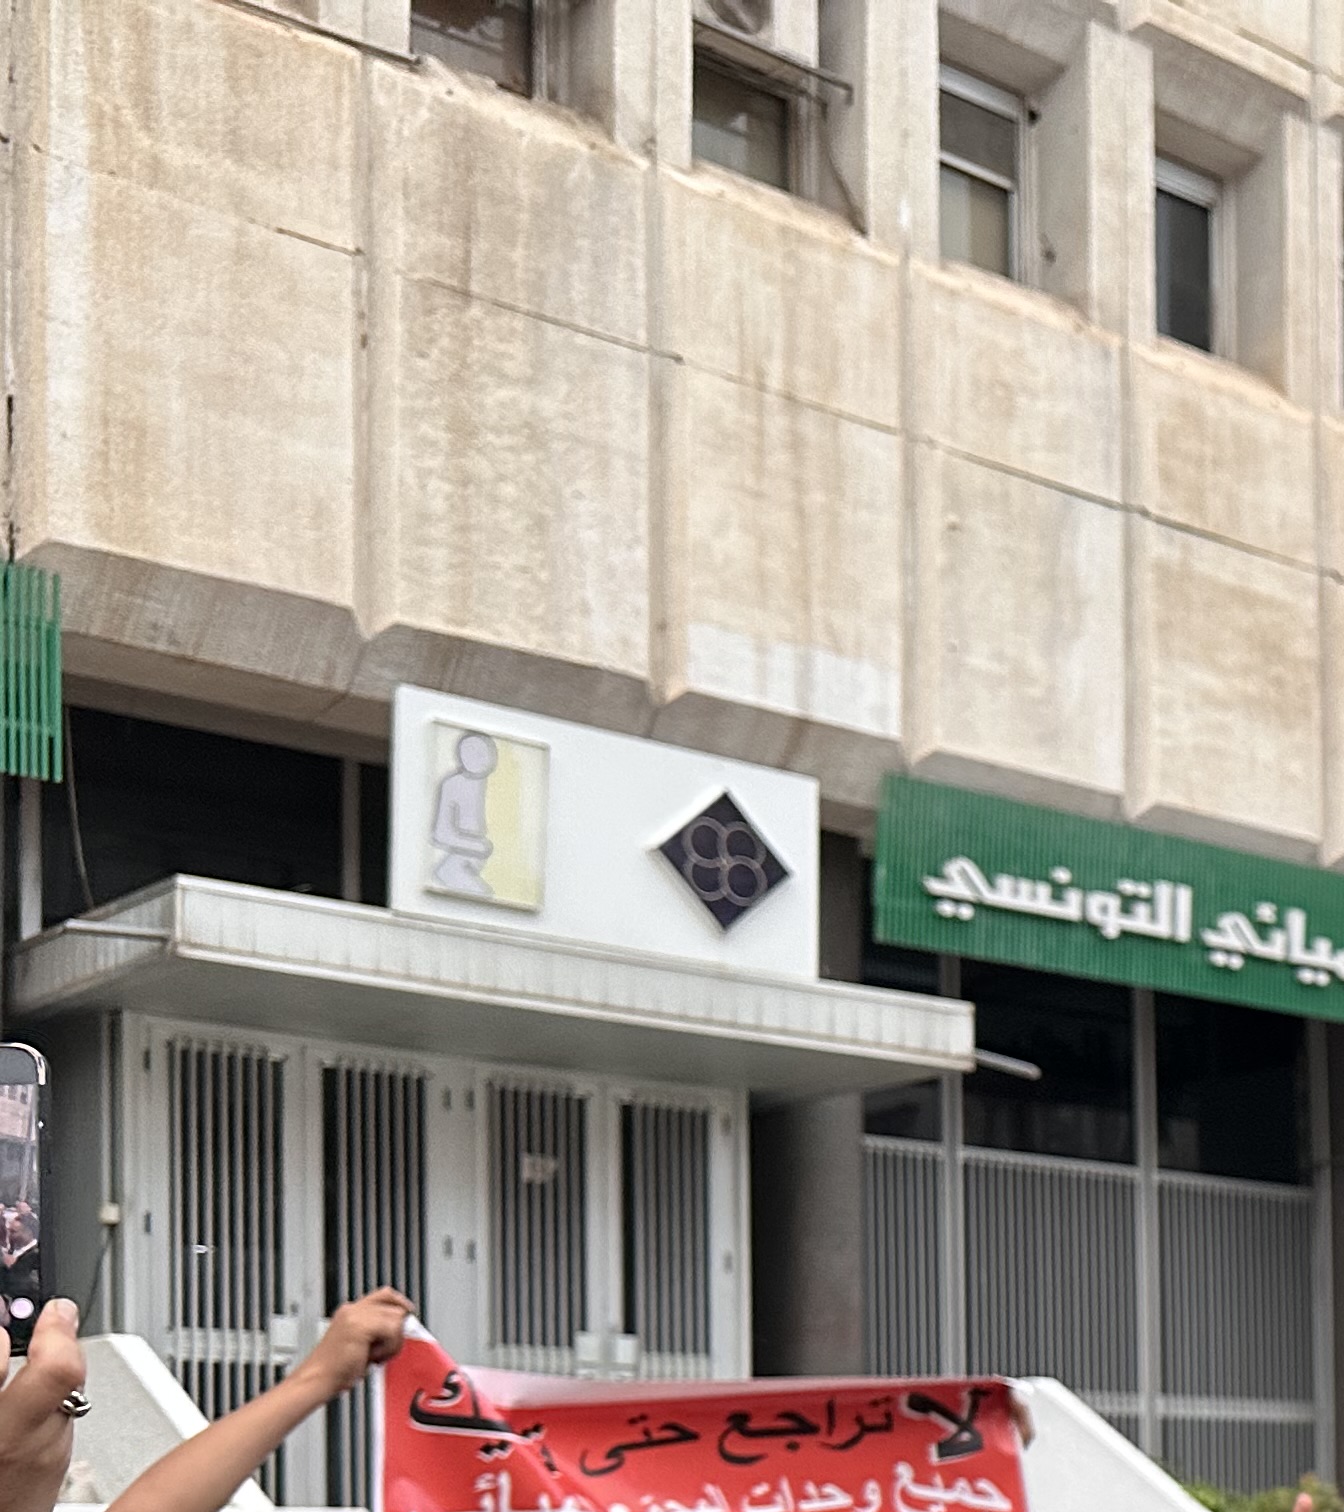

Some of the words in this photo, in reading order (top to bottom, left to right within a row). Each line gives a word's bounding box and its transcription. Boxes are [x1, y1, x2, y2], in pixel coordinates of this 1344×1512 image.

[923, 856, 1192, 943] التونسي
[579, 1413, 701, 1477] حتى
[718, 1394, 895, 1465] تراجع
[905, 1387, 992, 1463] لا
